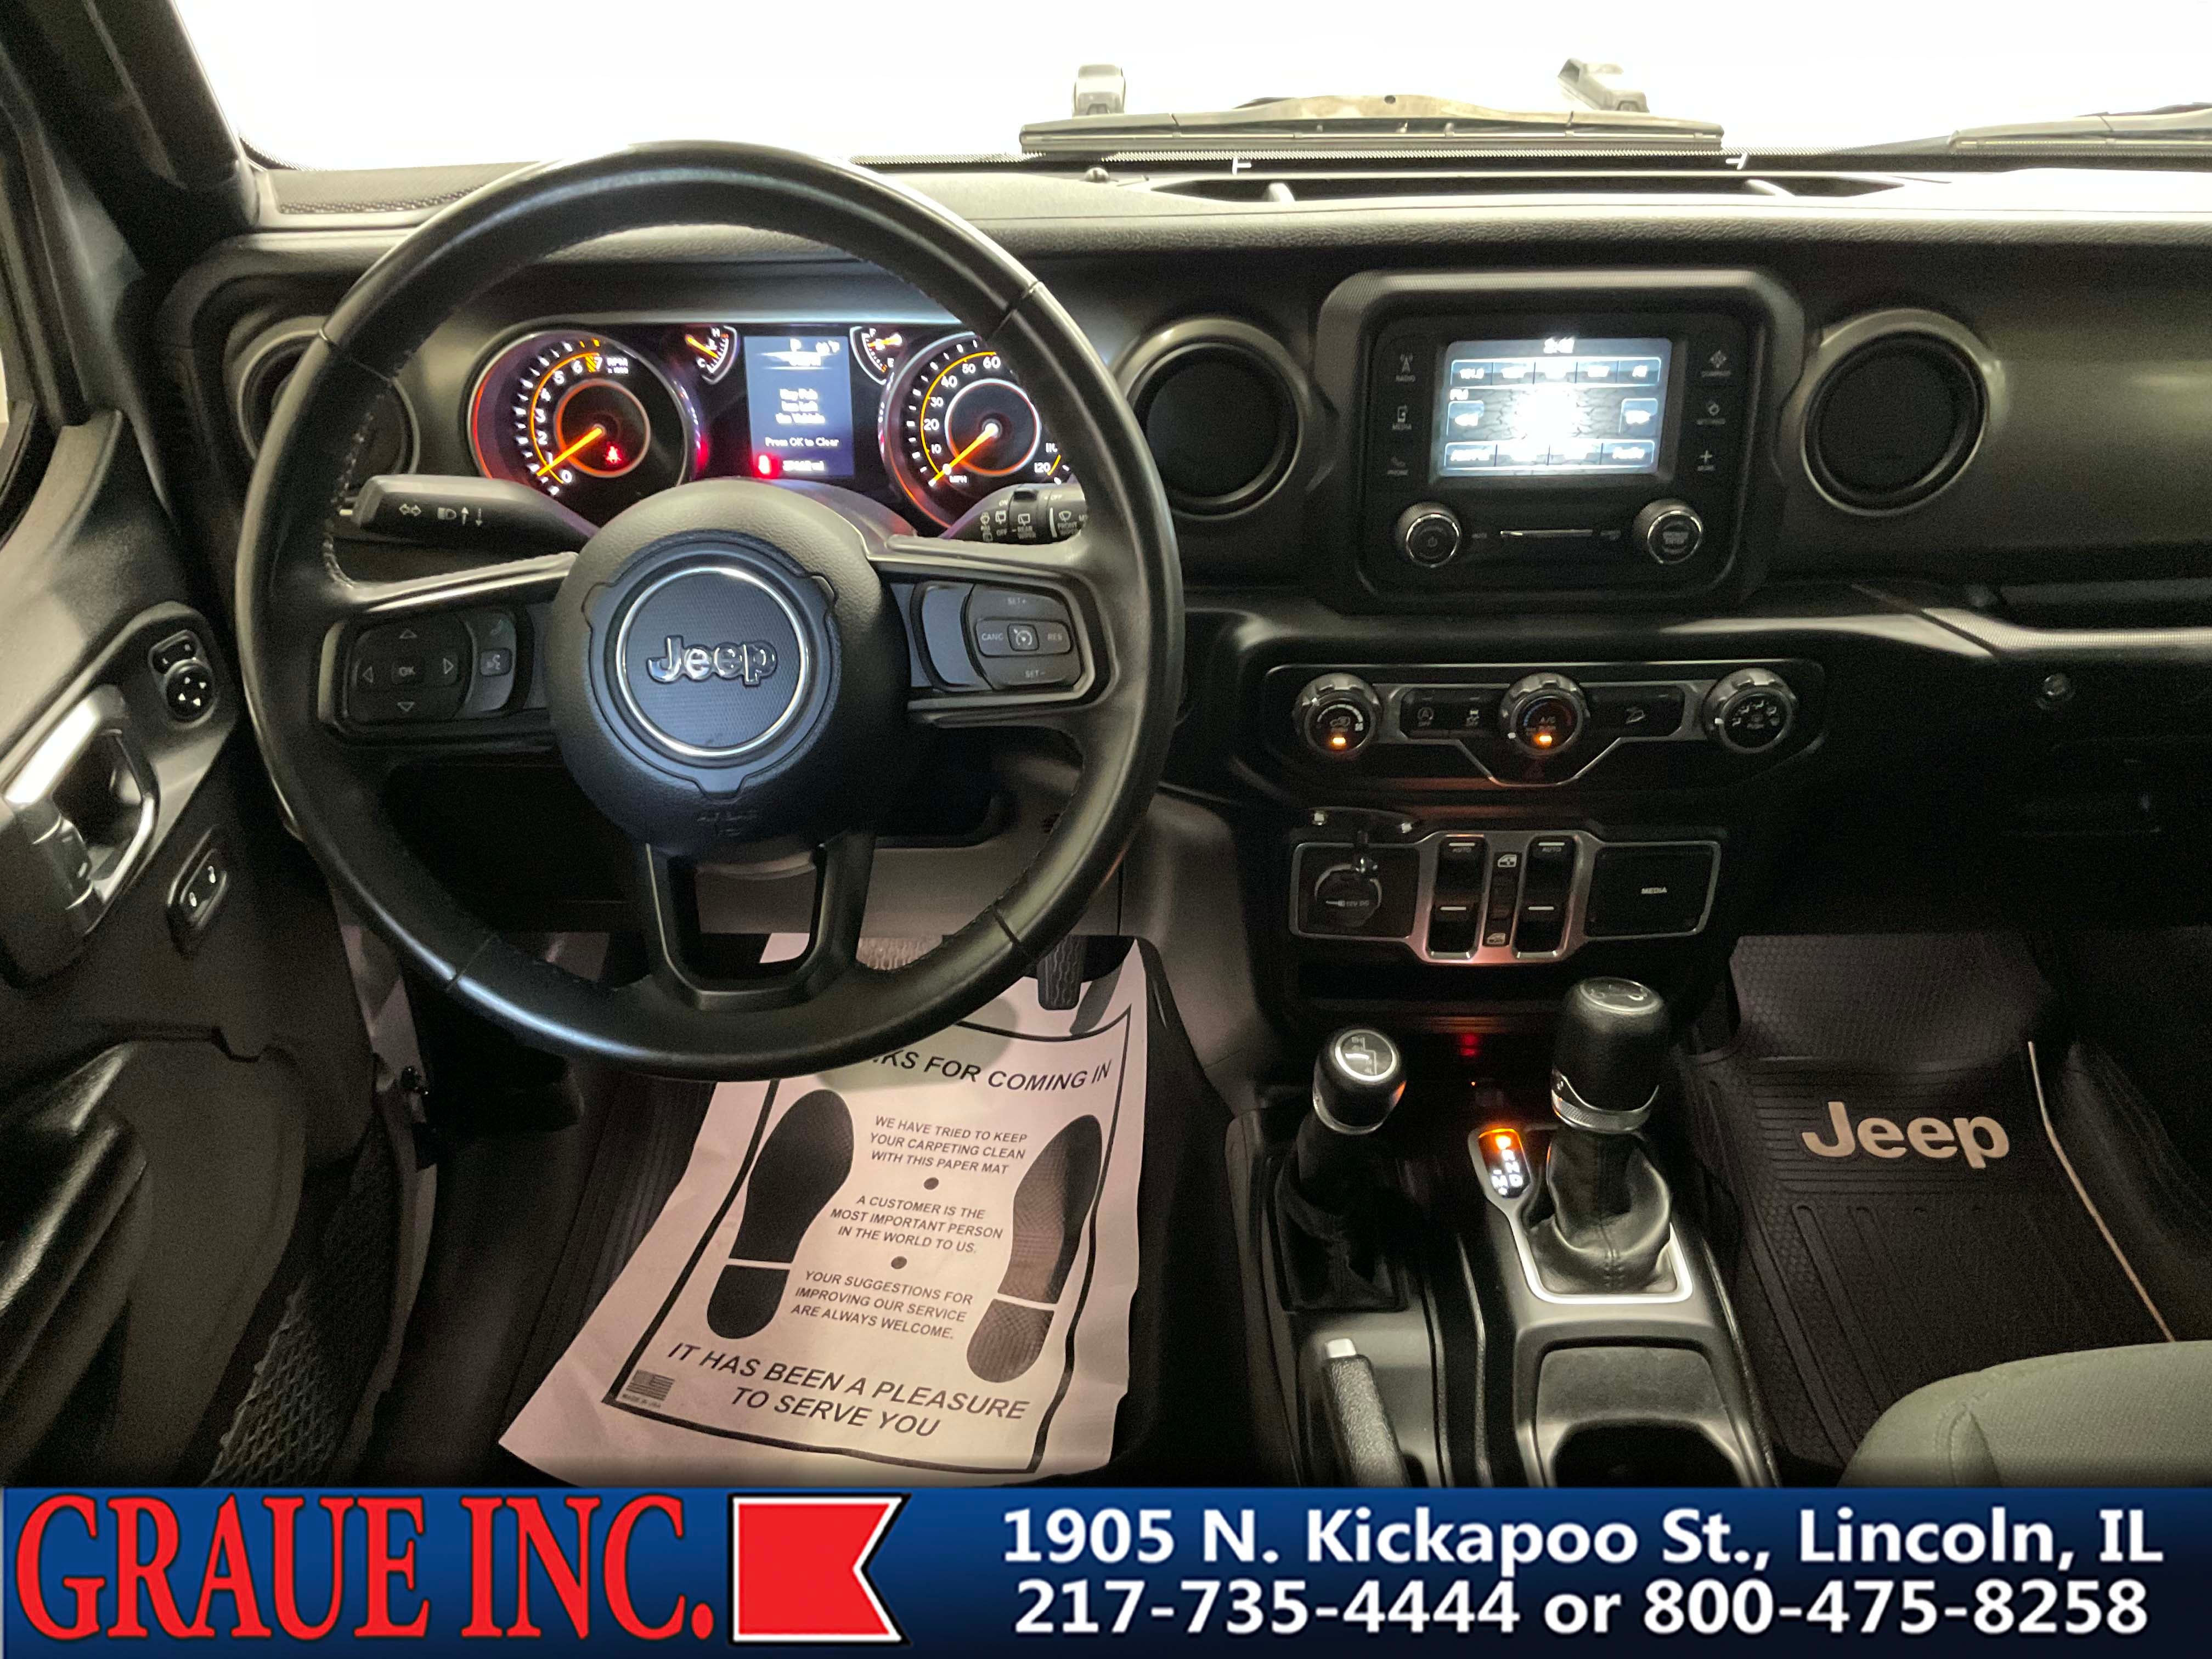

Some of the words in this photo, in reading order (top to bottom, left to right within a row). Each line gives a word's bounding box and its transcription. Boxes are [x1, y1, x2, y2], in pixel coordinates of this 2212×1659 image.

[573, 360, 583, 373] 6
[594, 357, 602, 370] 7
[697, 358, 706, 368] C
[962, 363, 975, 374] 50
[983, 356, 1001, 369] 60
[554, 370, 564, 384] 5
[941, 375, 958, 387] 40
[541, 388, 551, 401] 4
[930, 397, 944, 407] 30
[535, 408, 545, 422] 3
[924, 419, 939, 431] 20
[537, 431, 548, 445] 2
[765, 437, 788, 447] Press
[789, 437, 804, 446] OK
[816, 437, 839, 447] Clear
[931, 444, 941, 454] 10
[546, 452, 553, 465] 1
[1034, 462, 1051, 472] 120
[561, 469, 572, 483] 0
[981, 633, 1003, 641] CANC
[1047, 633, 1063, 641] RES
[646, 635, 777, 687] Jeep
[398, 666, 416, 677] OK
[924, 1057, 981, 1082] FOR
[989, 1071, 1087, 1091] COMING
[1092, 1060, 1111, 1084] IN
[876, 1116, 895, 1128] WE
[898, 1120, 931, 1133] HAVE
[936, 1126, 970, 1138] TRIED
[976, 1131, 990, 1140] TO
[994, 1132, 1027, 1142] KEEP
[1802, 1101, 2010, 1169] Jeep
[871, 1133, 904, 1147] YOUR
[908, 1139, 979, 1155] CARPETING
[983, 1147, 1025, 1159] CLEAN
[872, 1151, 903, 1163] WITH
[907, 1155, 933, 1166] THIS
[936, 1159, 978, 1171] PAPER
[982, 1163, 1008, 1173] MAT
[1505, 1161, 1520, 1173] N
[1492, 1175, 1508, 1187] M
[1509, 1174, 1523, 1187] D
[856, 1195, 865, 1204] A
[870, 1197, 941, 1214] CUSTOMER
[944, 1206, 956, 1215] IS
[961, 1208, 985, 1218] THE
[831, 1209, 868, 1221] MOST
[870, 1214, 945, 1231] IMPORTANT
[948, 1223, 1002, 1238] PERSON
[838, 1227, 852, 1236] IN
[856, 1228, 880, 1240] THE
[884, 1232, 932, 1246] WORLD
[936, 1239, 952, 1249] TO
[957, 1242, 976, 1252] US.
[806, 1271, 842, 1284] YOUR
[845, 1277, 940, 1299] SUGGESTIONS
[944, 1291, 973, 1305] FOR
[795, 1288, 870, 1306] IMPROVING
[874, 1299, 904, 1311] OUR
[907, 1304, 966, 1322] SERVICE
[791, 1305, 820, 1317] ARE
[822, 1309, 877, 1326] ALWAYS
[882, 1318, 952, 1339] WELCOME.
[668, 1343, 701, 1361] IT
[699, 1350, 757, 1377] HAS
[764, 1363, 845, 1390] BEEN
[844, 1378, 866, 1395] A
[872, 1381, 1030, 1419] PLEASURE
[732, 1387, 769, 1408] TO
[774, 1396, 872, 1426] SERVE
[879, 1412, 940, 1436] YOU
